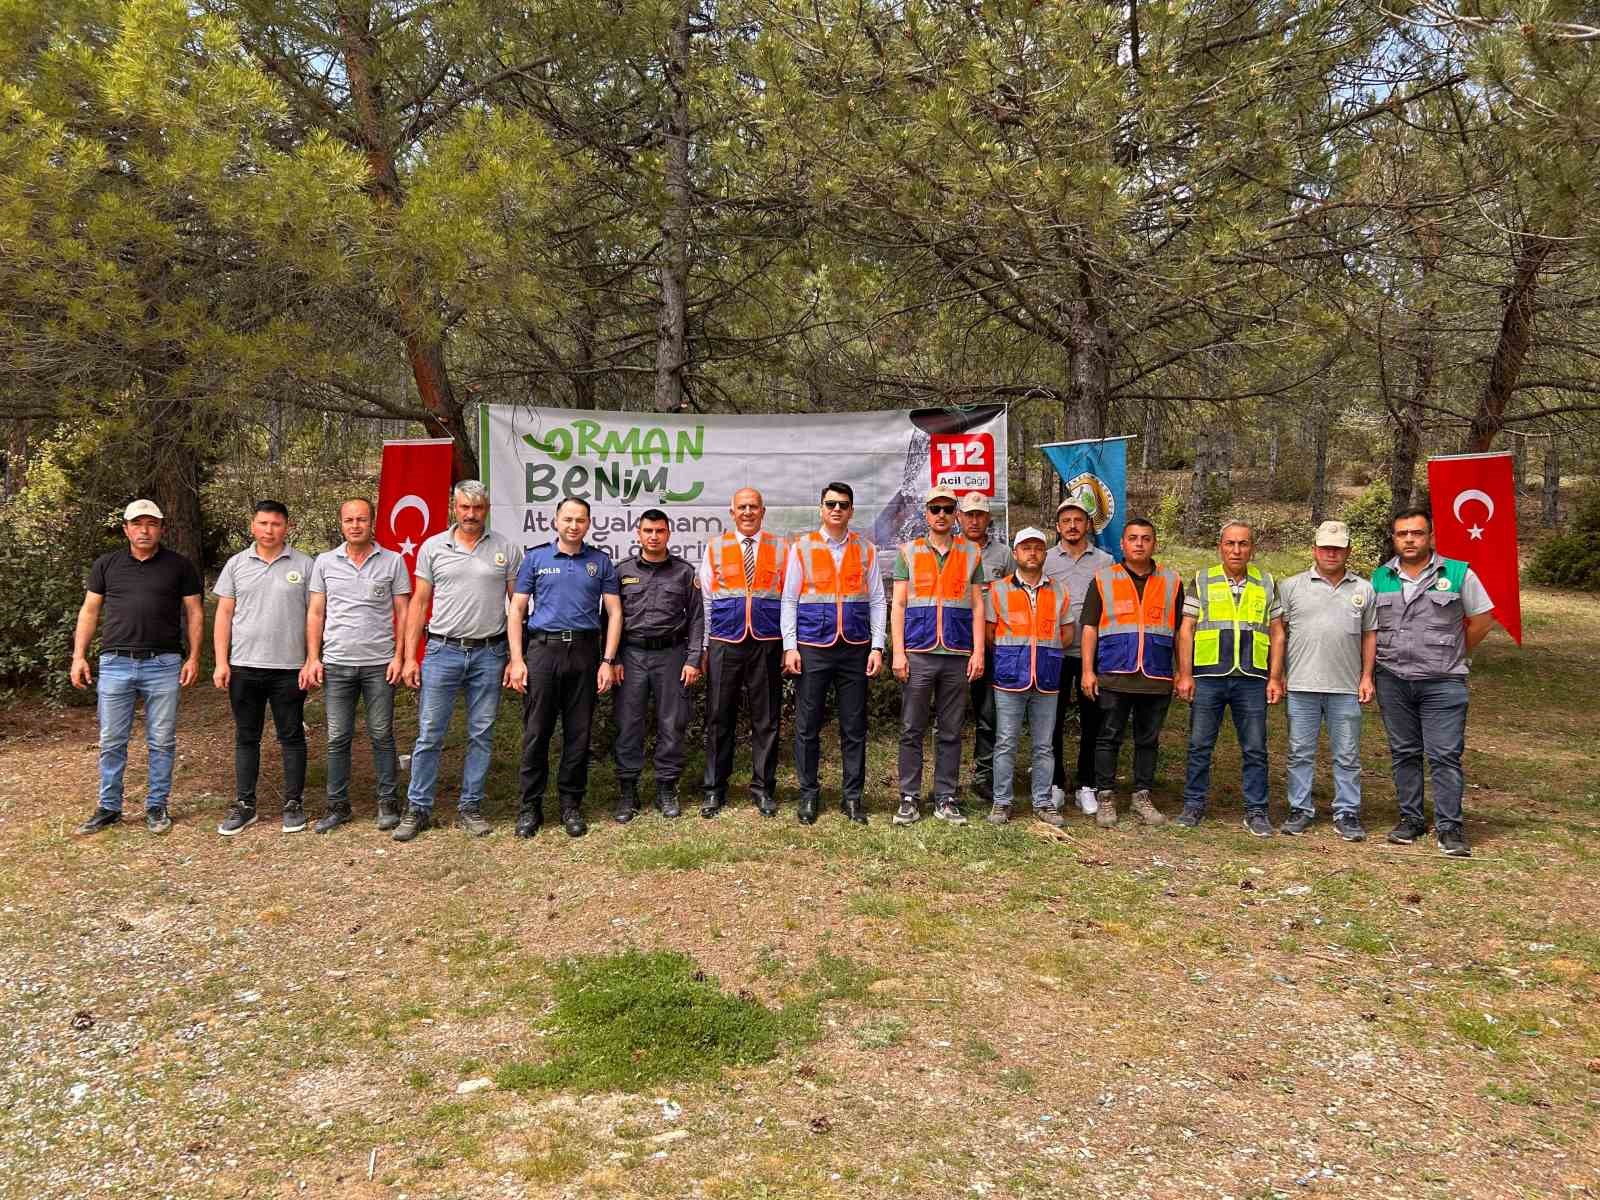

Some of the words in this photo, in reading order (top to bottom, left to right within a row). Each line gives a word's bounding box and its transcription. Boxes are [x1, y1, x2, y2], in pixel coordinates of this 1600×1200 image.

[522, 419, 705, 466] ORMAN
[936, 441, 985, 467] 112
[940, 476, 961, 485] Acil
[523, 509, 559, 533] At
